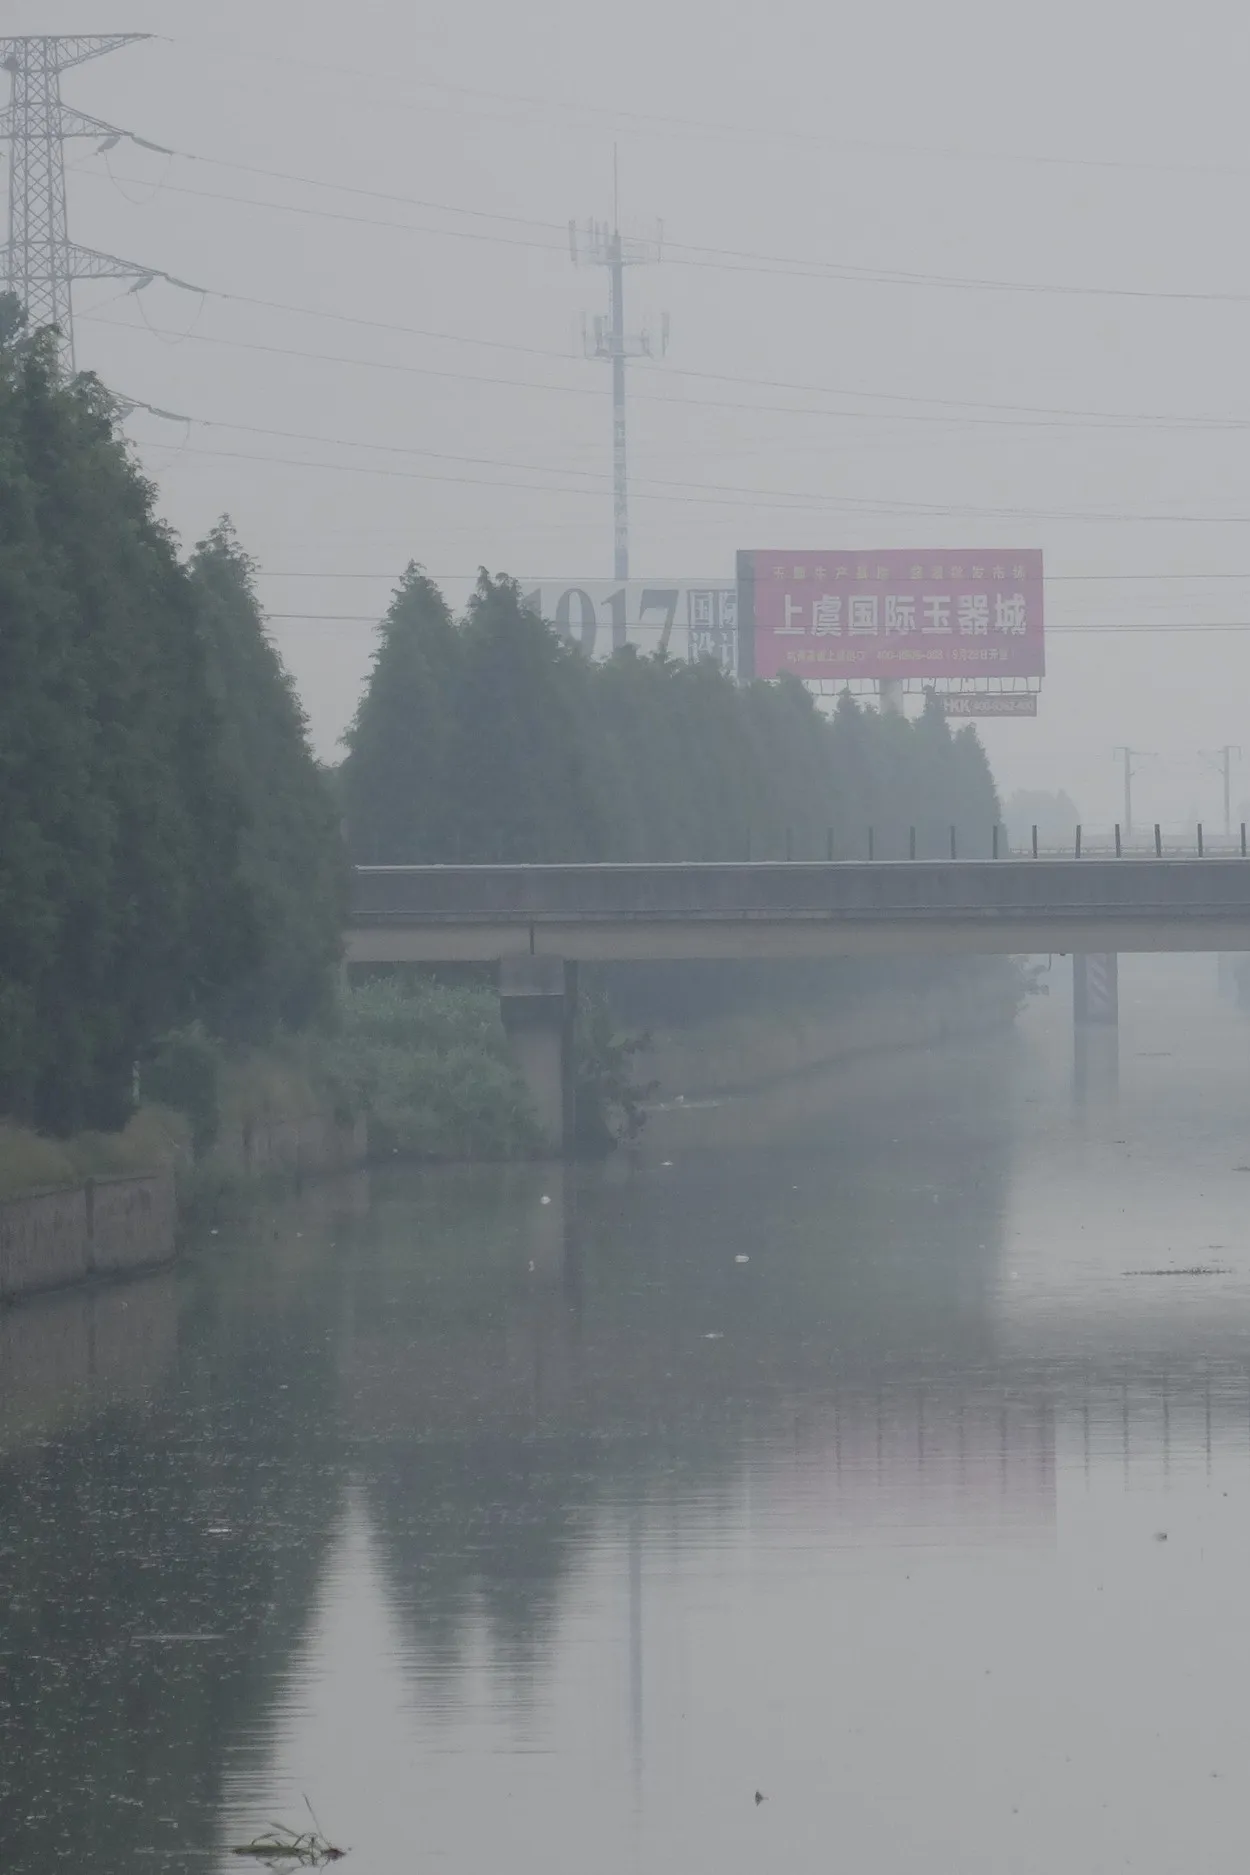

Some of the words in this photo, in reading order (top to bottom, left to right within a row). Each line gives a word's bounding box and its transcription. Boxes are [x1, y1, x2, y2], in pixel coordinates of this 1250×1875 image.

[773, 593, 1027, 636] 上虞国际玉器城
